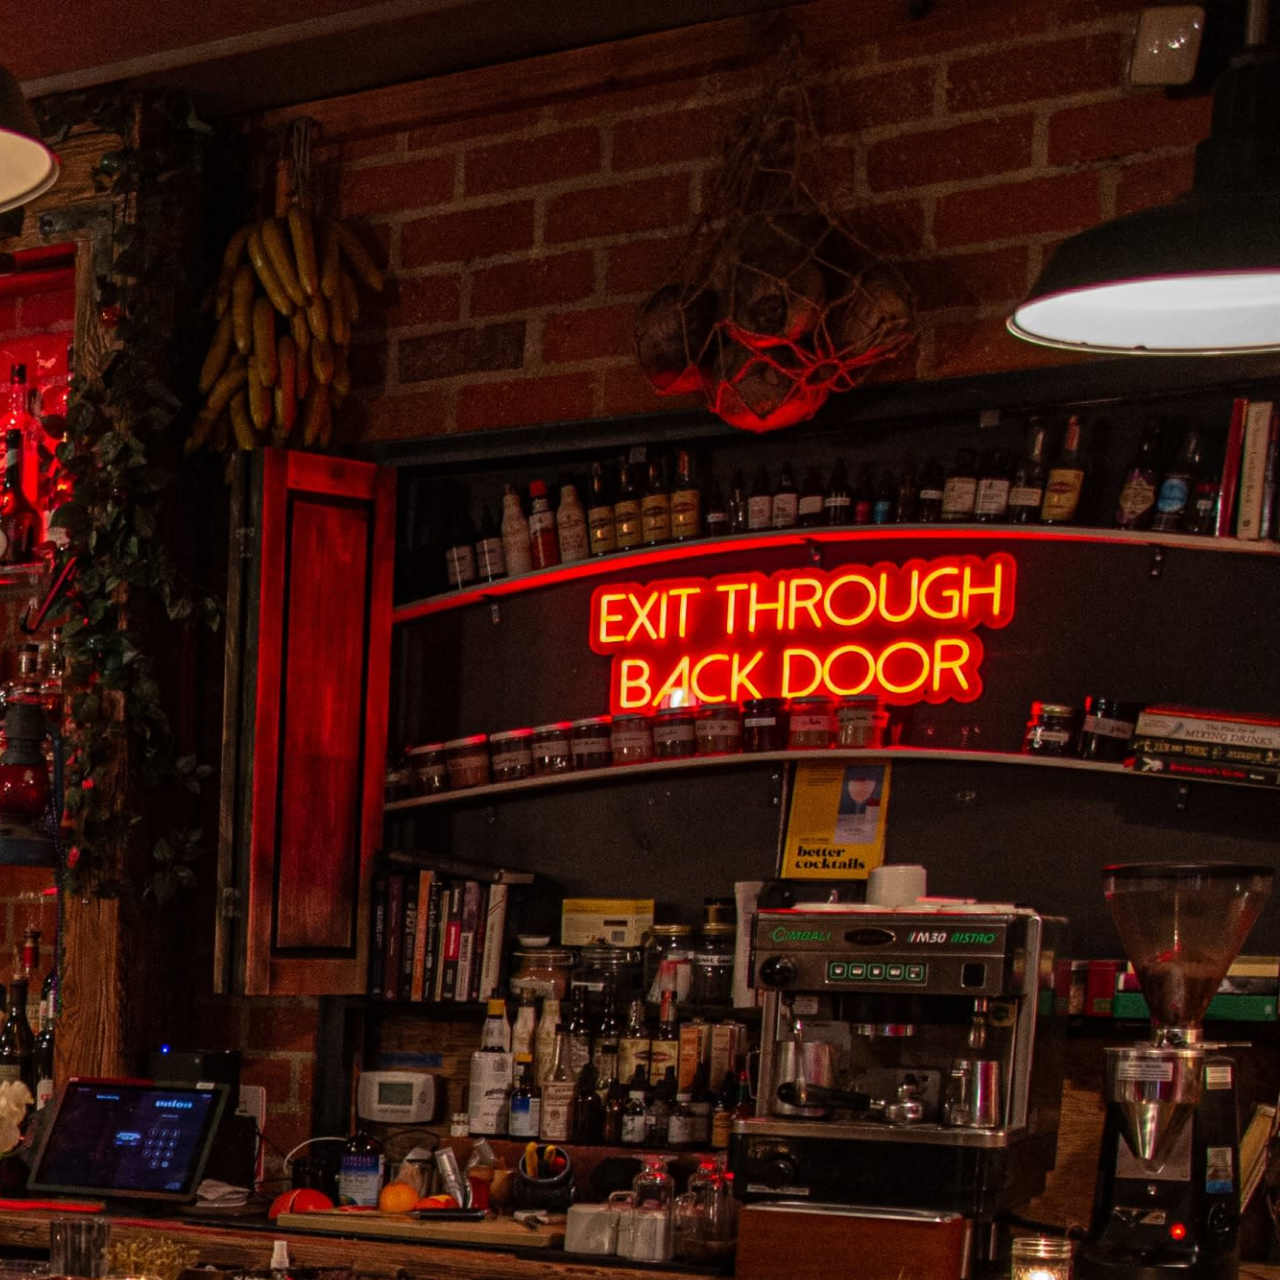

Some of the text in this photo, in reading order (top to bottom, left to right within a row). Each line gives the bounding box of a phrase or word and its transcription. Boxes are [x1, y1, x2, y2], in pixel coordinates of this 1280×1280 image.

[598, 563, 1003, 643] EXIT THROUGH
[618, 637, 970, 708] BACK DOOR
[1184, 729, 1272, 746] MIXING DRINKS
[797, 845, 846, 857] better
[795, 857, 865, 870] cocktails
[771, 926, 832, 943] CIMBALI
[915, 927, 998, 944] M30 BISTRO
